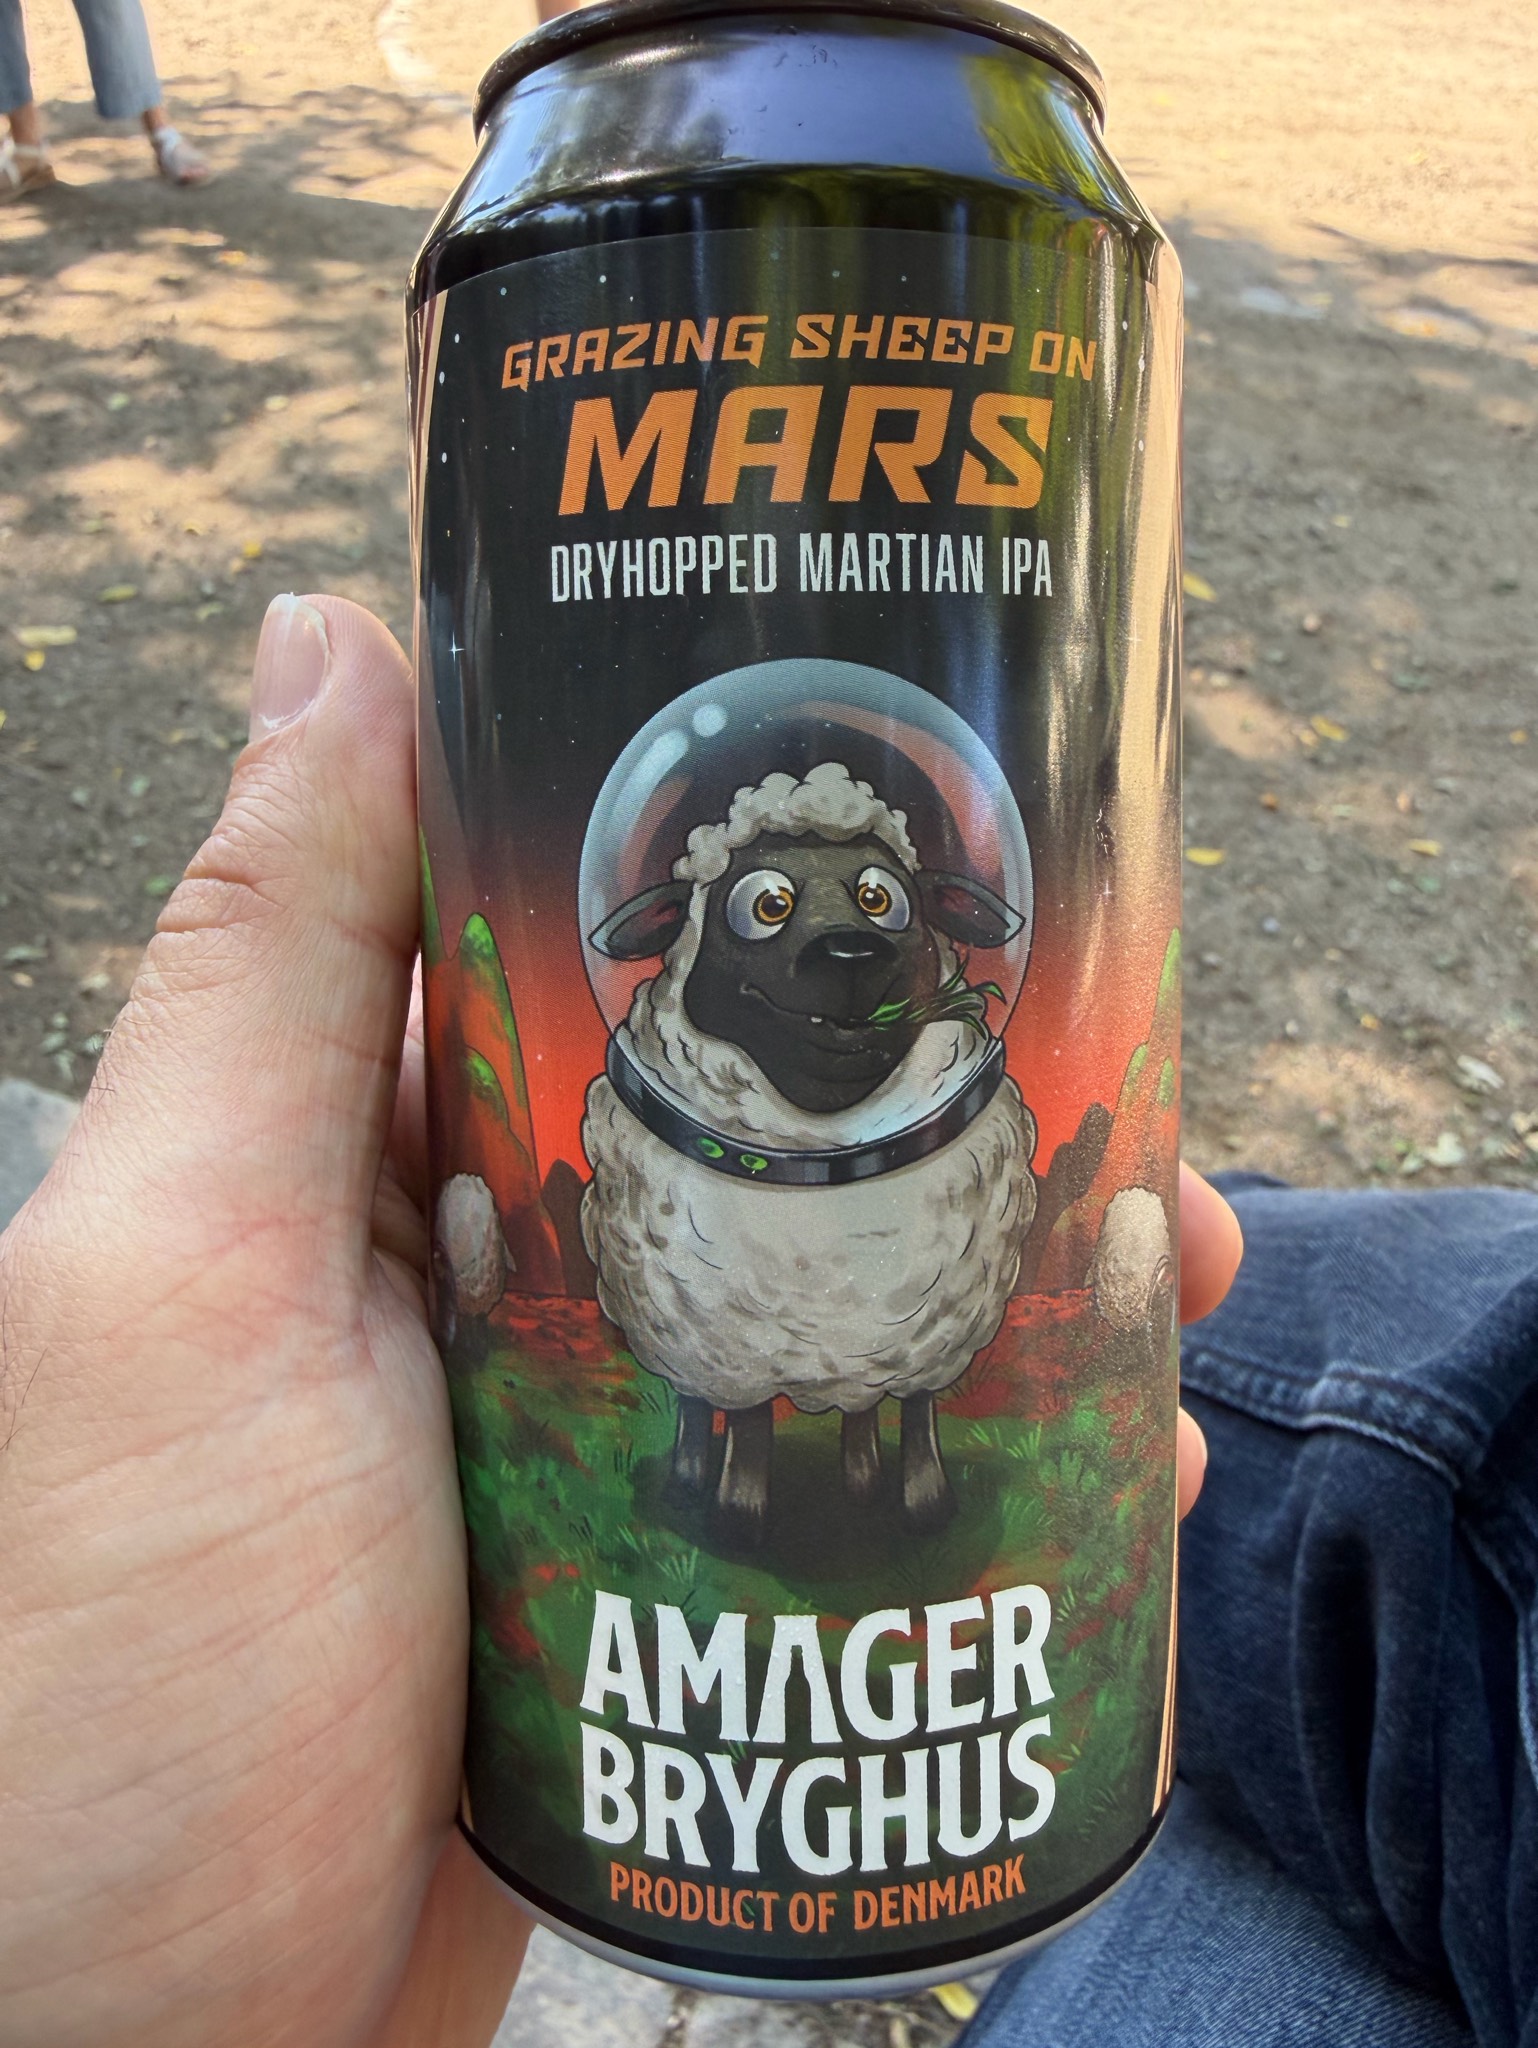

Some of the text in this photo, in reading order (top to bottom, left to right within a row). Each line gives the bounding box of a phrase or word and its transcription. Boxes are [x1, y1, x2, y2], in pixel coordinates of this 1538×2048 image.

[501, 314, 1096, 391] GRAZING SHEEP ON
[557, 385, 1053, 515] MARS
[551, 532, 1053, 602] DRYHOPPED MARTIAN IPA
[580, 1584, 1055, 1743] AMAGER
[580, 1715, 1056, 1876] BRYGHUS
[610, 1855, 1026, 1934] PRODUCT OF DENMARK
